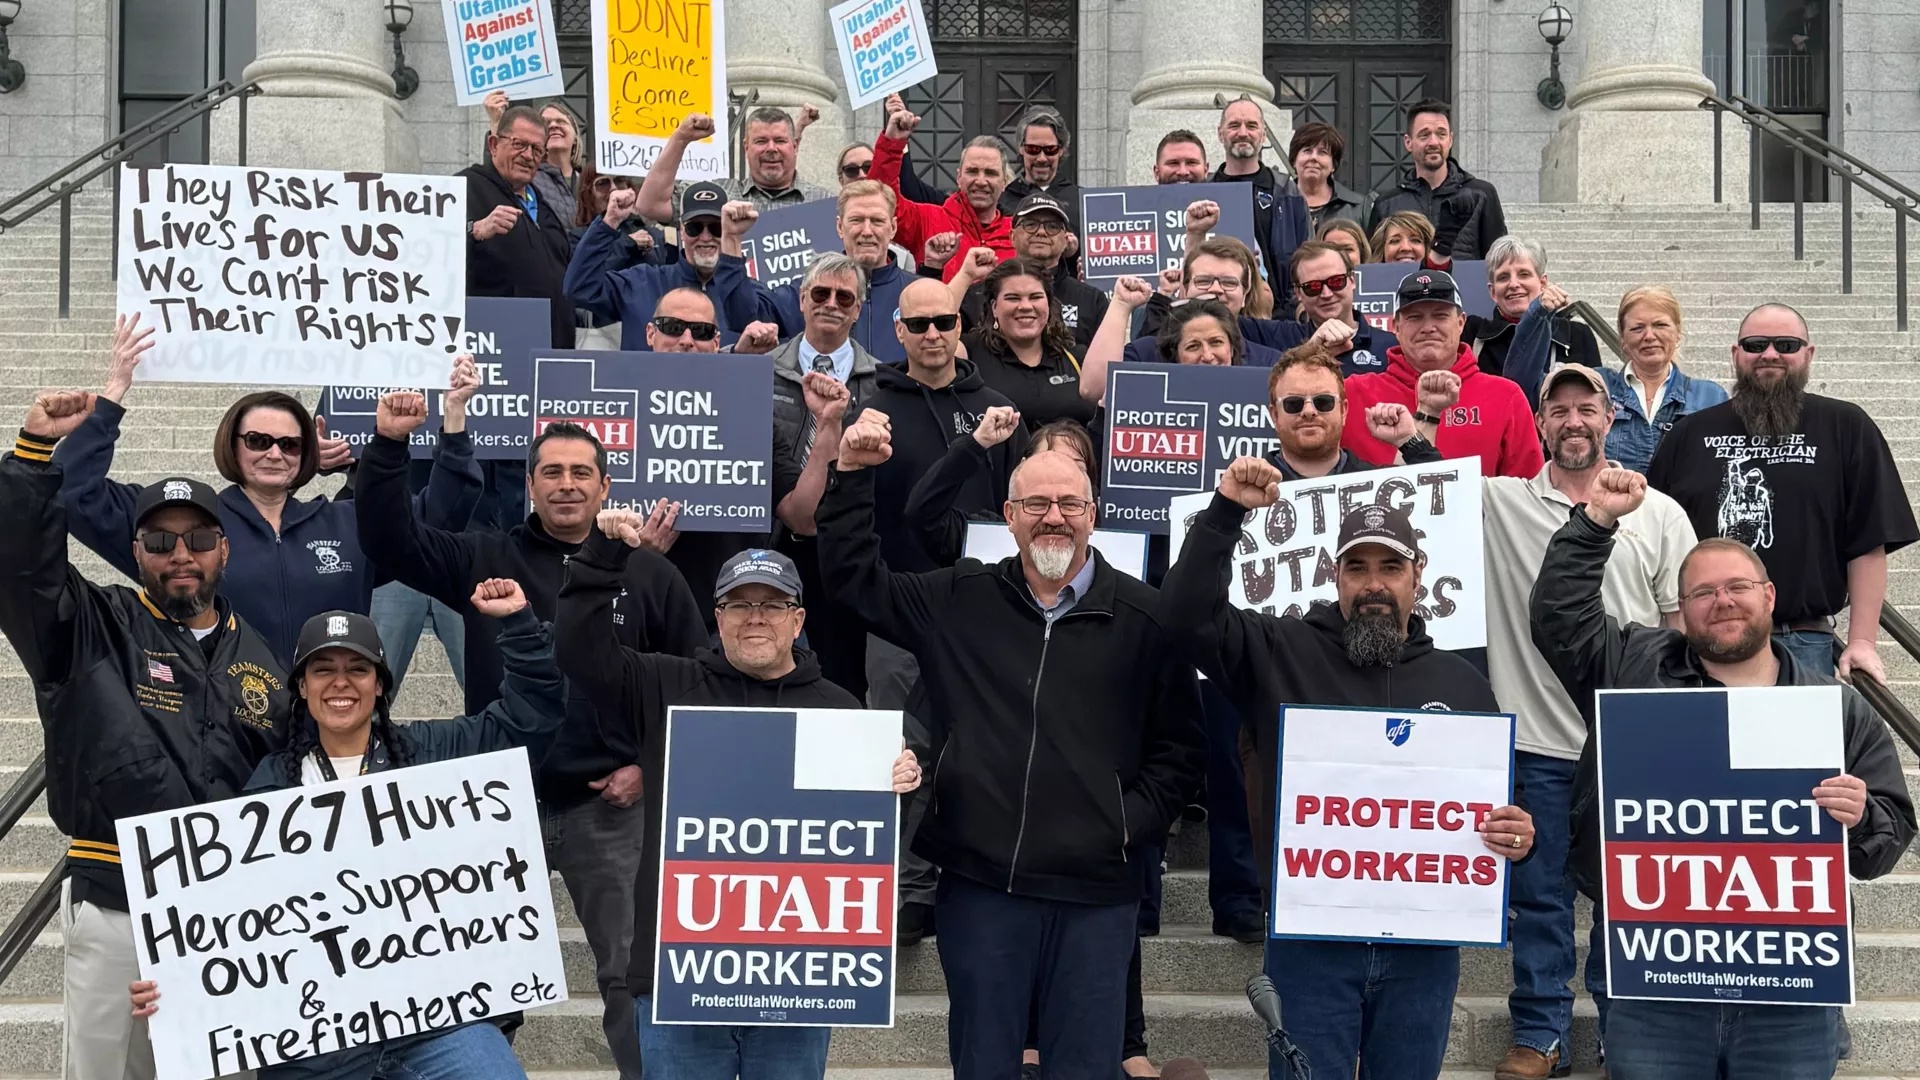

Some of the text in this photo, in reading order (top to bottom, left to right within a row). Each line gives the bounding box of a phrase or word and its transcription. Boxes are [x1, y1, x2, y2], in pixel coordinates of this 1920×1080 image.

[459, 0, 530, 21] Utahn
[465, 6, 534, 42] Against
[616, 0, 710, 48] DONT
[852, 5, 908, 51] Against
[466, 30, 537, 65] Power
[855, 24, 910, 72] Power
[470, 54, 542, 88] Grabs
[859, 45, 917, 90] Grabs
[622, 70, 695, 107] Come
[126, 161, 231, 222] They
[344, 171, 457, 217] Their
[133, 207, 237, 252] Lives
[245, 213, 330, 260] for
[761, 228, 812, 252] SIGN.
[1088, 219, 1152, 233] PROTECT
[1088, 234, 1153, 254] UTAH
[1088, 254, 1154, 267] WORKERS
[134, 256, 203, 293] We
[150, 297, 275, 334] Their
[1352, 301, 1389, 313] TECT
[465, 332, 501, 355] GN.
[479, 363, 508, 386] TE.
[335, 387, 421, 400] WORK
[540, 399, 629, 416] PROTECT
[649, 390, 718, 416] SIGN.
[1116, 410, 1200, 428] PROTECT
[1453, 406, 1482, 427] 81
[649, 424, 724, 451] VOTE.
[1114, 430, 1199, 457] UTAH
[1703, 433, 1806, 449] VOICE OF THE
[1715, 444, 1818, 459] ELECTRICIAN
[647, 458, 767, 486] PROTECT.
[1113, 458, 1199, 476] WORKERS
[1104, 502, 1171, 521] Protect
[227, 661, 284, 691] TEAMSTERS
[234, 706, 260, 722] LOCAL
[361, 780, 513, 847] Hurts
[1295, 794, 1494, 833] PROTECT
[1614, 798, 1822, 836] PROTECT
[675, 816, 885, 857] PROTECT
[1284, 847, 1498, 887] WORKERS
[1615, 854, 1837, 914] UTAH
[141, 847, 528, 966] Heroes: Support
[673, 873, 885, 935] UTAH
[311, 904, 540, 978] Teachers
[1616, 927, 1841, 968] WORKERS
[668, 949, 885, 988] WORKERS
[1644, 970, 1814, 989] ProtectUtahWorkers.com
[300, 980, 325, 1020] &
[691, 993, 856, 1011] ProtectUtahWorkers.com
[208, 981, 493, 1078] Firefighters
